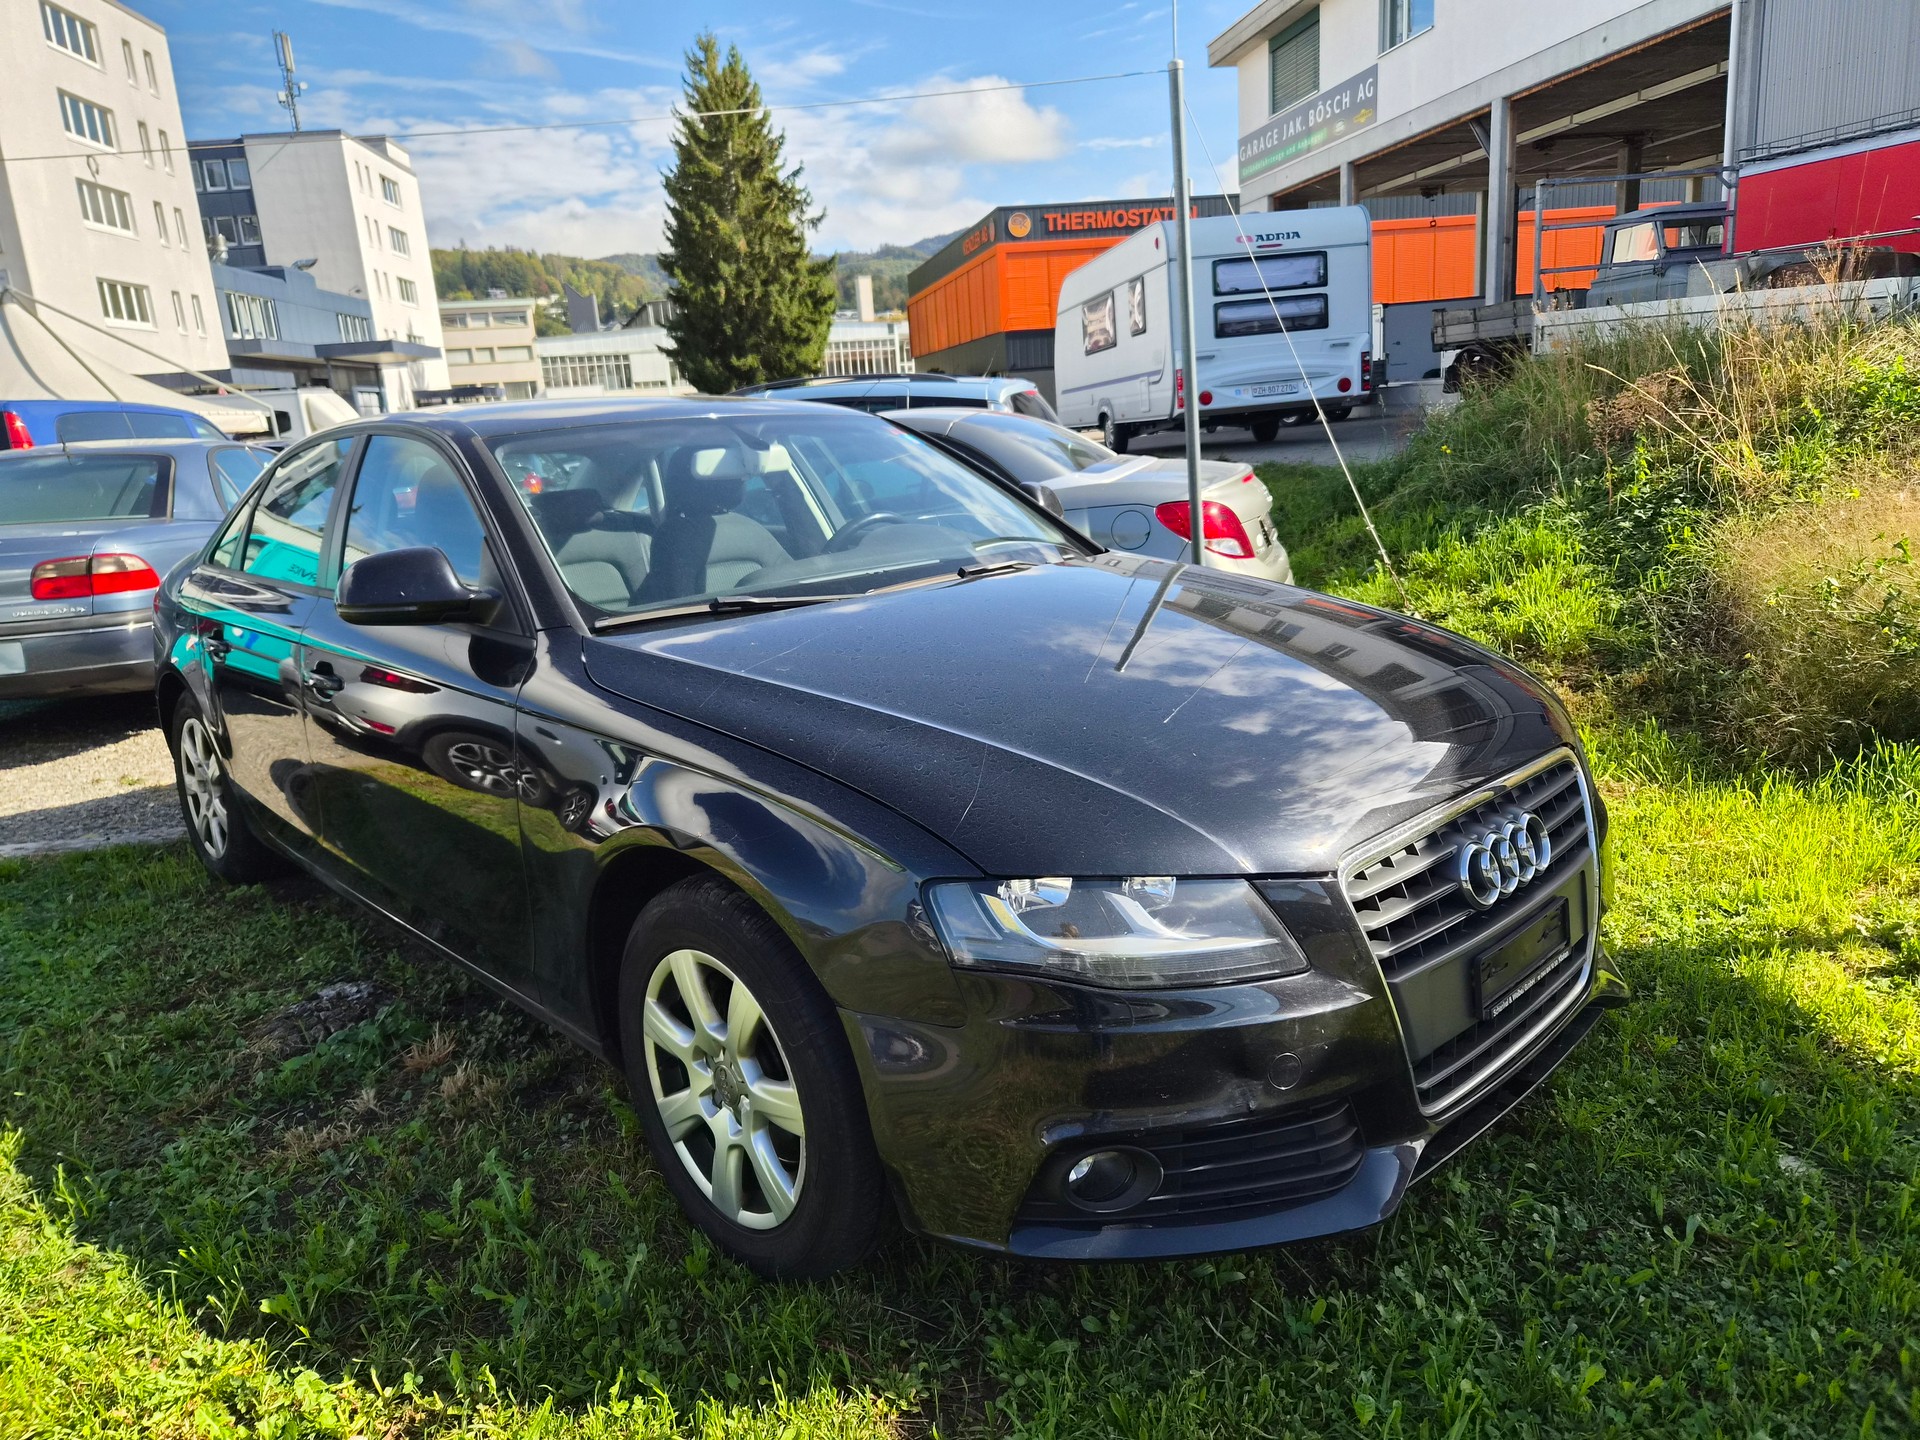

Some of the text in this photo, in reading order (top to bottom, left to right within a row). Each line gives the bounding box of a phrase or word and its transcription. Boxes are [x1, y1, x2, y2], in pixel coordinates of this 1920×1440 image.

[1240, 128, 1278, 162] GARAGE
[1282, 117, 1305, 142] JAK.
[1309, 90, 1350, 127] BÖSCH
[1357, 78, 1373, 103] AG
[1255, 231, 1301, 242] ADRIA
